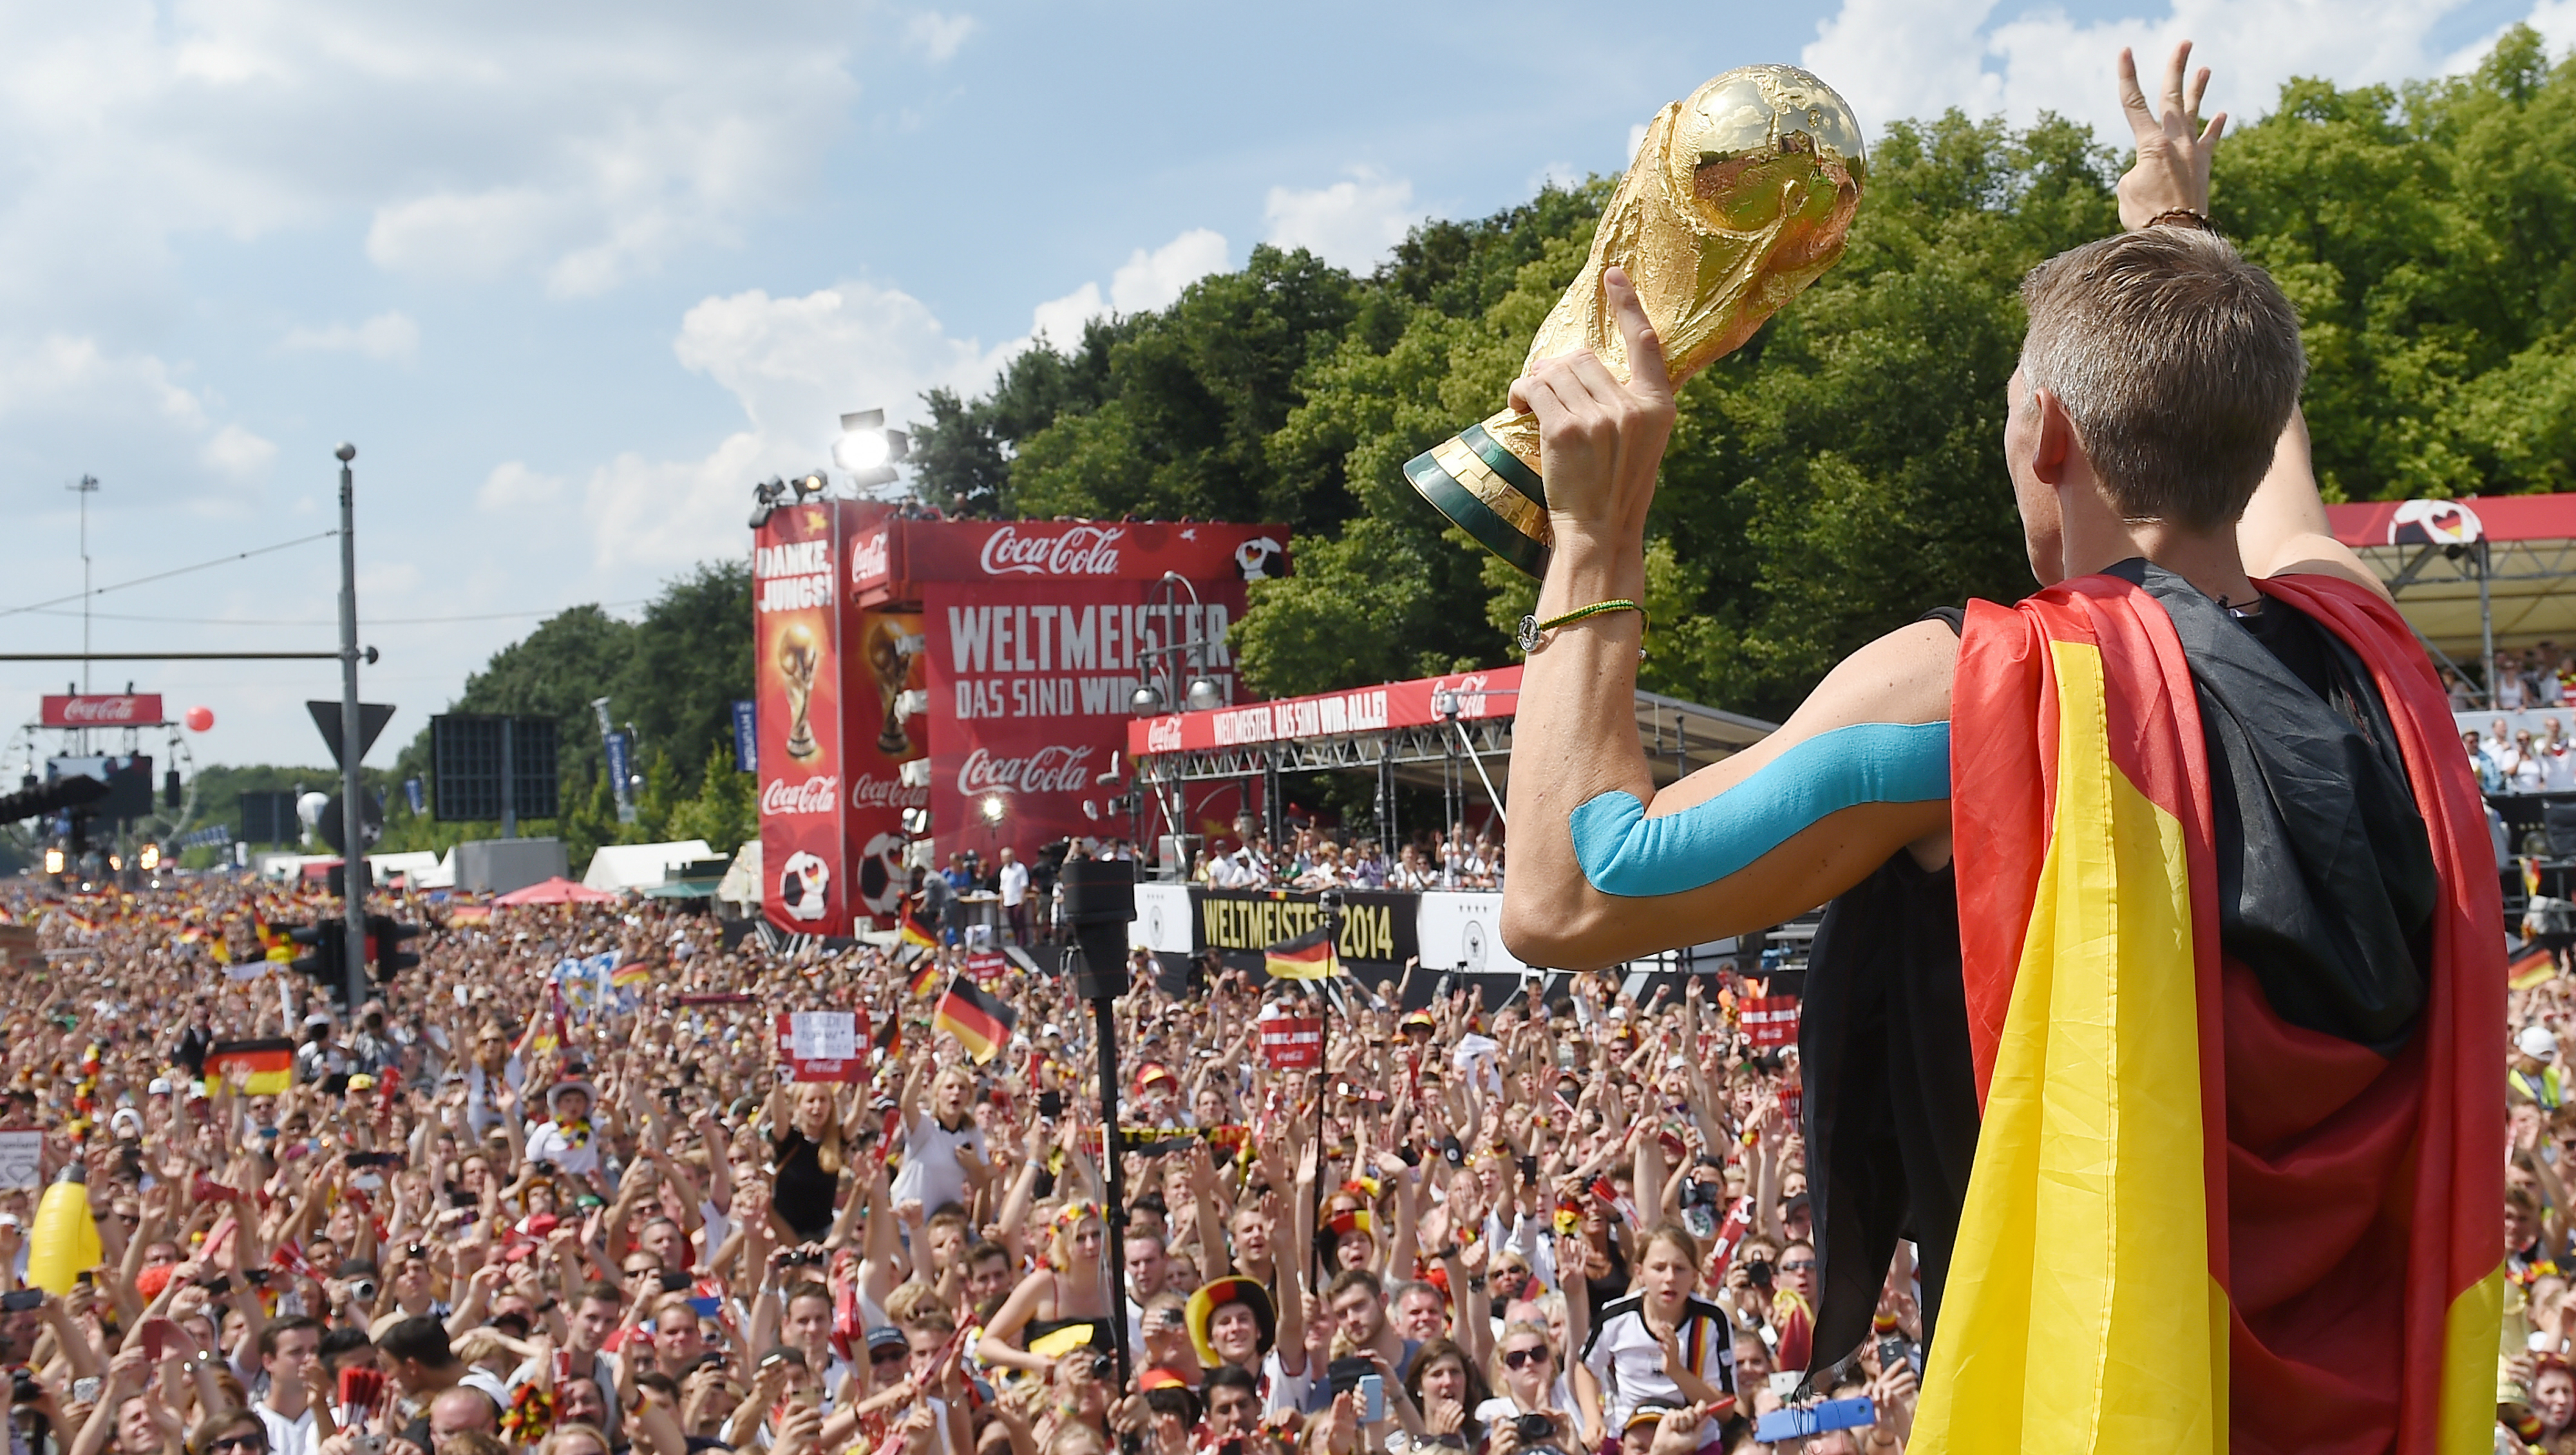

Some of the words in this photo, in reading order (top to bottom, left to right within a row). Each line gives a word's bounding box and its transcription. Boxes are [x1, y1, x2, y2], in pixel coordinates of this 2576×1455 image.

[756, 540, 832, 578] DANKE,
[980, 525, 1126, 574] Coca-Cola
[758, 574, 833, 612] JUNGS!
[64, 697, 135, 721] Coca-Cola
[956, 679, 1004, 718] DAS
[1012, 677, 1074, 717] SIND
[1275, 703, 1296, 739] DAS
[1295, 700, 1320, 737] SIND
[1320, 696, 1347, 734] WIR
[1348, 690, 1388, 732] ALLE!
[957, 745, 1094, 796] Coca-Cola
[762, 775, 837, 816] Coca-Cola
[1338, 904, 1394, 960] 2014
